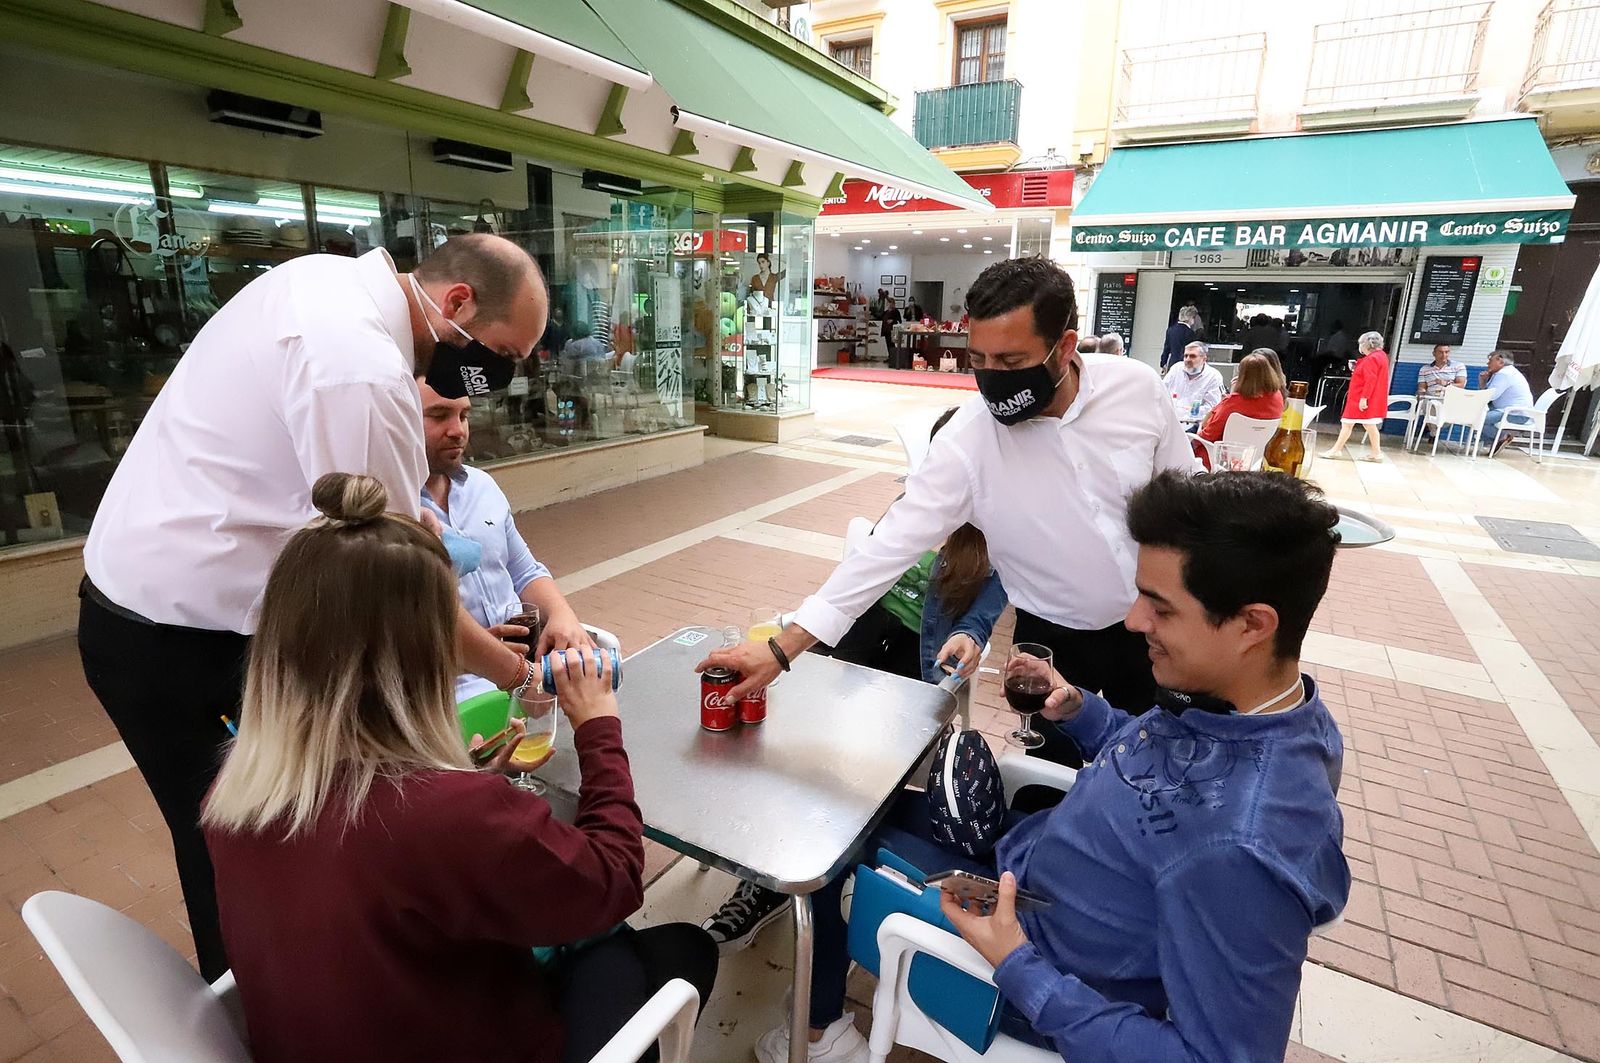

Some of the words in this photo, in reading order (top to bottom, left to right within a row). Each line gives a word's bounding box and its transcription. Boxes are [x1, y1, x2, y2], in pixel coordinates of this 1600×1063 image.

[1075, 231, 1114, 245] Centro
[1117, 229, 1157, 246] Suizo
[1164, 226, 1226, 248] CAFE
[1235, 225, 1286, 246] BAR
[1297, 220, 1429, 245] AGMANIR
[1440, 220, 1497, 237] Centro
[1501, 217, 1561, 237] Suizo
[1193, 254, 1222, 264] 1963
